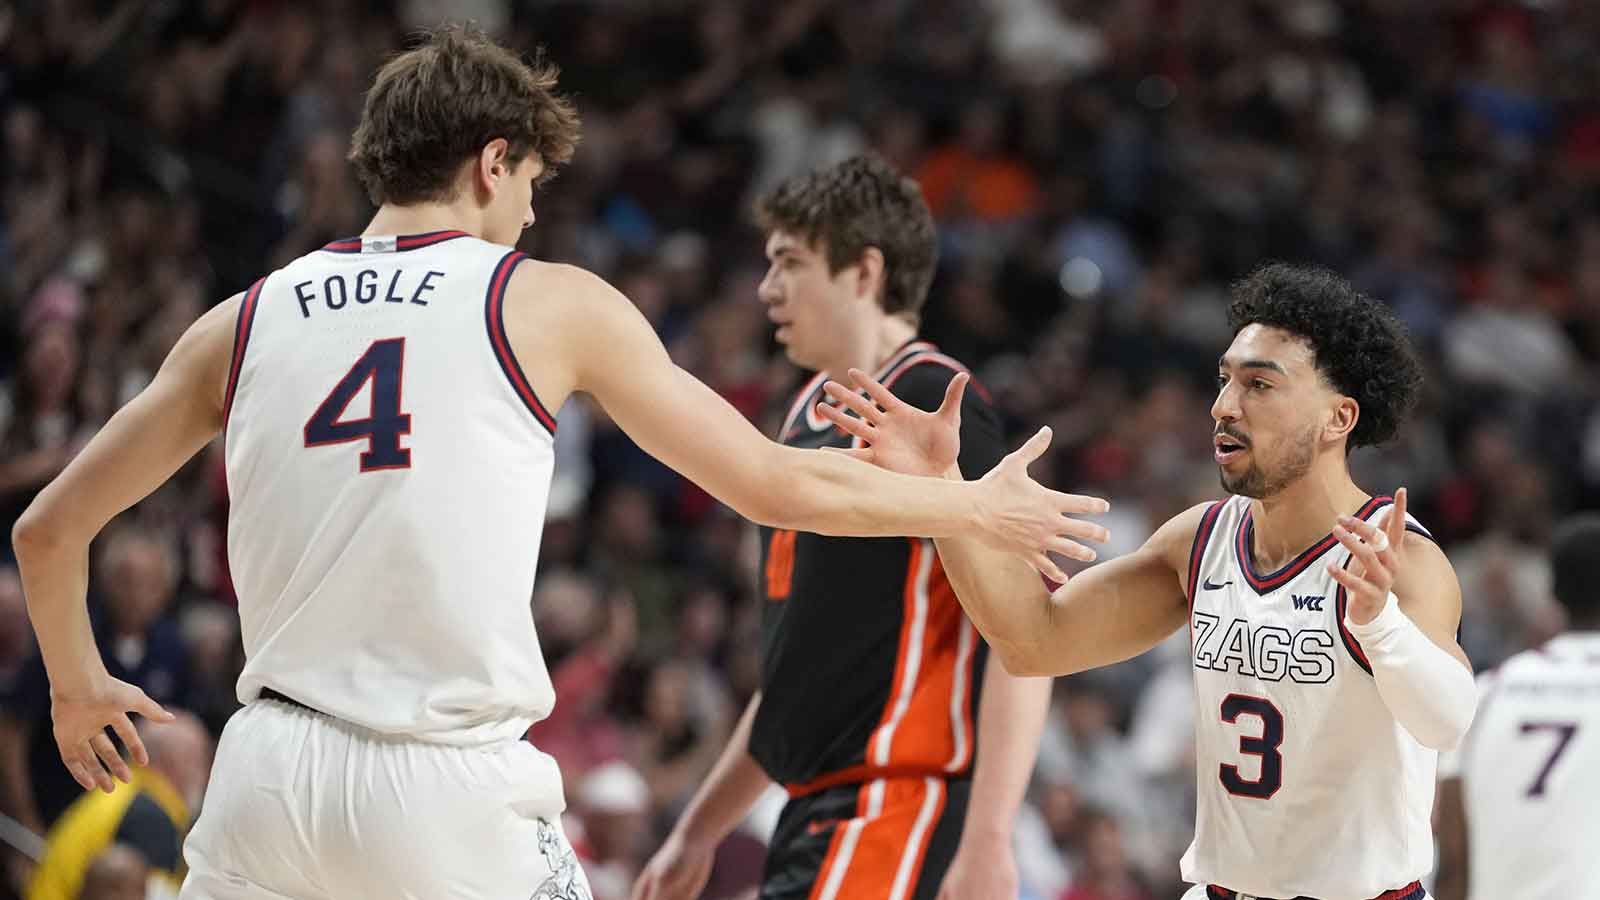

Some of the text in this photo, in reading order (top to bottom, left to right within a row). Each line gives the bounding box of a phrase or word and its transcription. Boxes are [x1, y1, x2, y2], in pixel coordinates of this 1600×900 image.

[294, 269, 445, 318] FOGLE
[303, 336, 411, 473] 4
[1291, 594, 1327, 612] WCC
[1193, 611, 1335, 684] ZAGS
[1219, 693, 1284, 800] 3
[1519, 721, 1578, 799] 7
